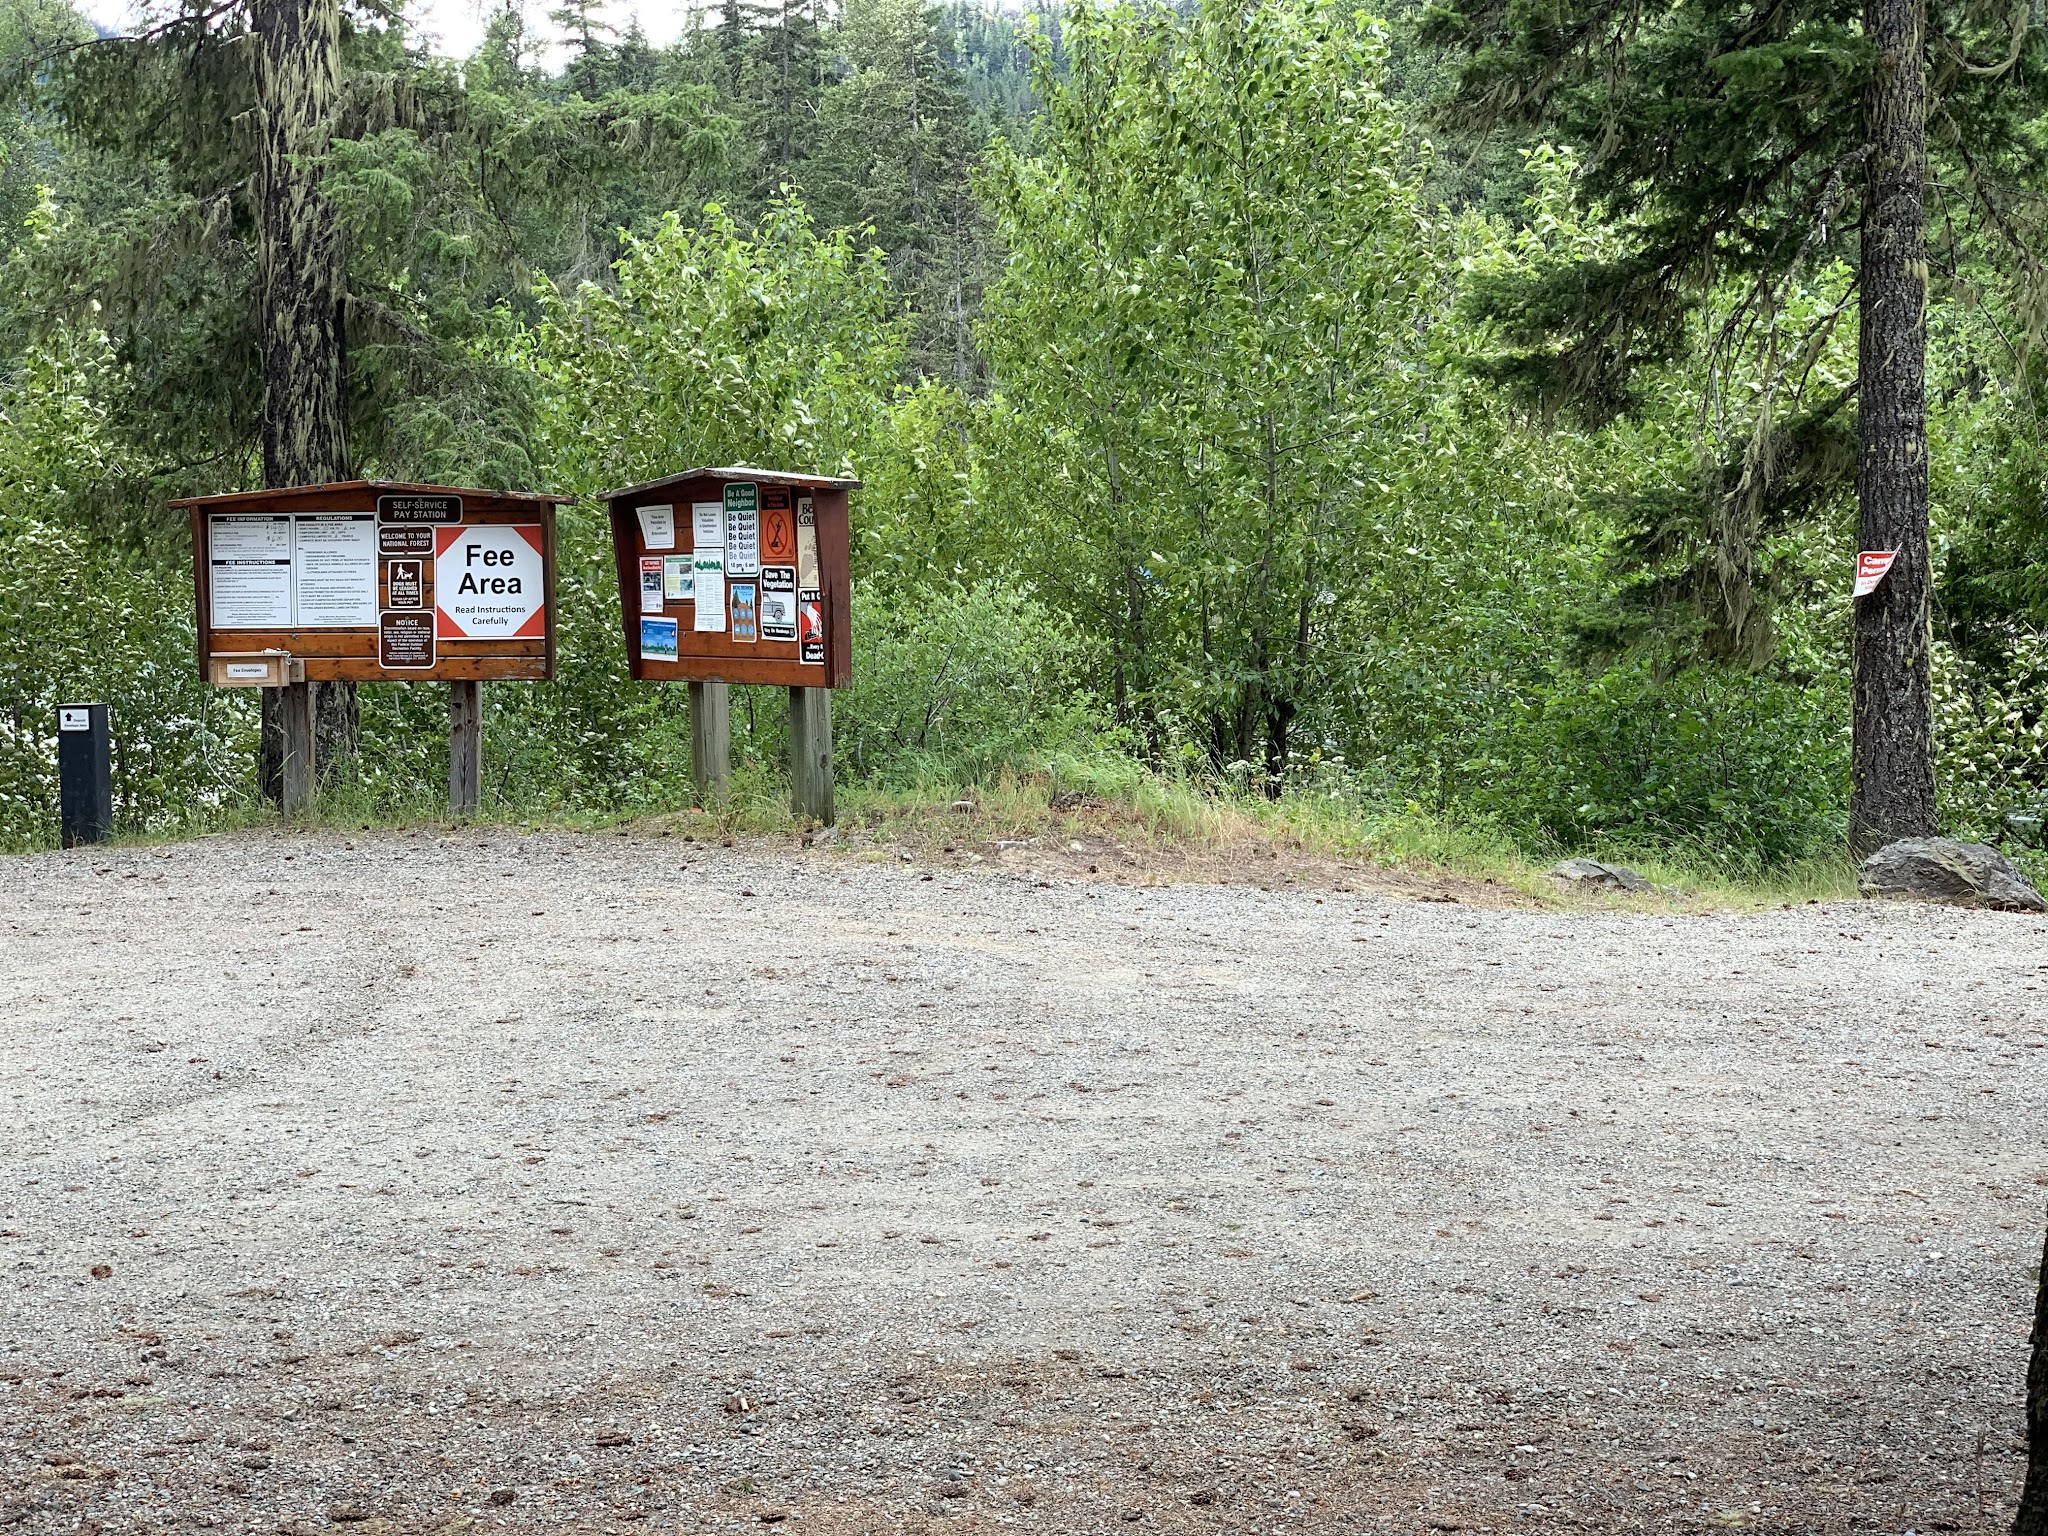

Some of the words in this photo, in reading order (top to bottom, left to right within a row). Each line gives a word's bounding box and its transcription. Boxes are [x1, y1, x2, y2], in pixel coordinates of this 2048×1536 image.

[727, 498, 755, 508] Neighbor
[738, 512, 755, 521] Quiet
[728, 523, 736, 531] Be
[738, 522, 755, 531] Quiet
[738, 532, 755, 540] Quiet
[728, 542, 737, 550] Be
[738, 542, 756, 550] Quiet
[466, 544, 514, 566] Fee
[729, 552, 737, 560] Be
[739, 551, 756, 560] Quiet
[765, 570, 778, 580] Save
[780, 570, 791, 579] The
[458, 572, 522, 594] Area
[763, 580, 793, 590] Vegetation
[472, 617, 508, 626] Carefully
